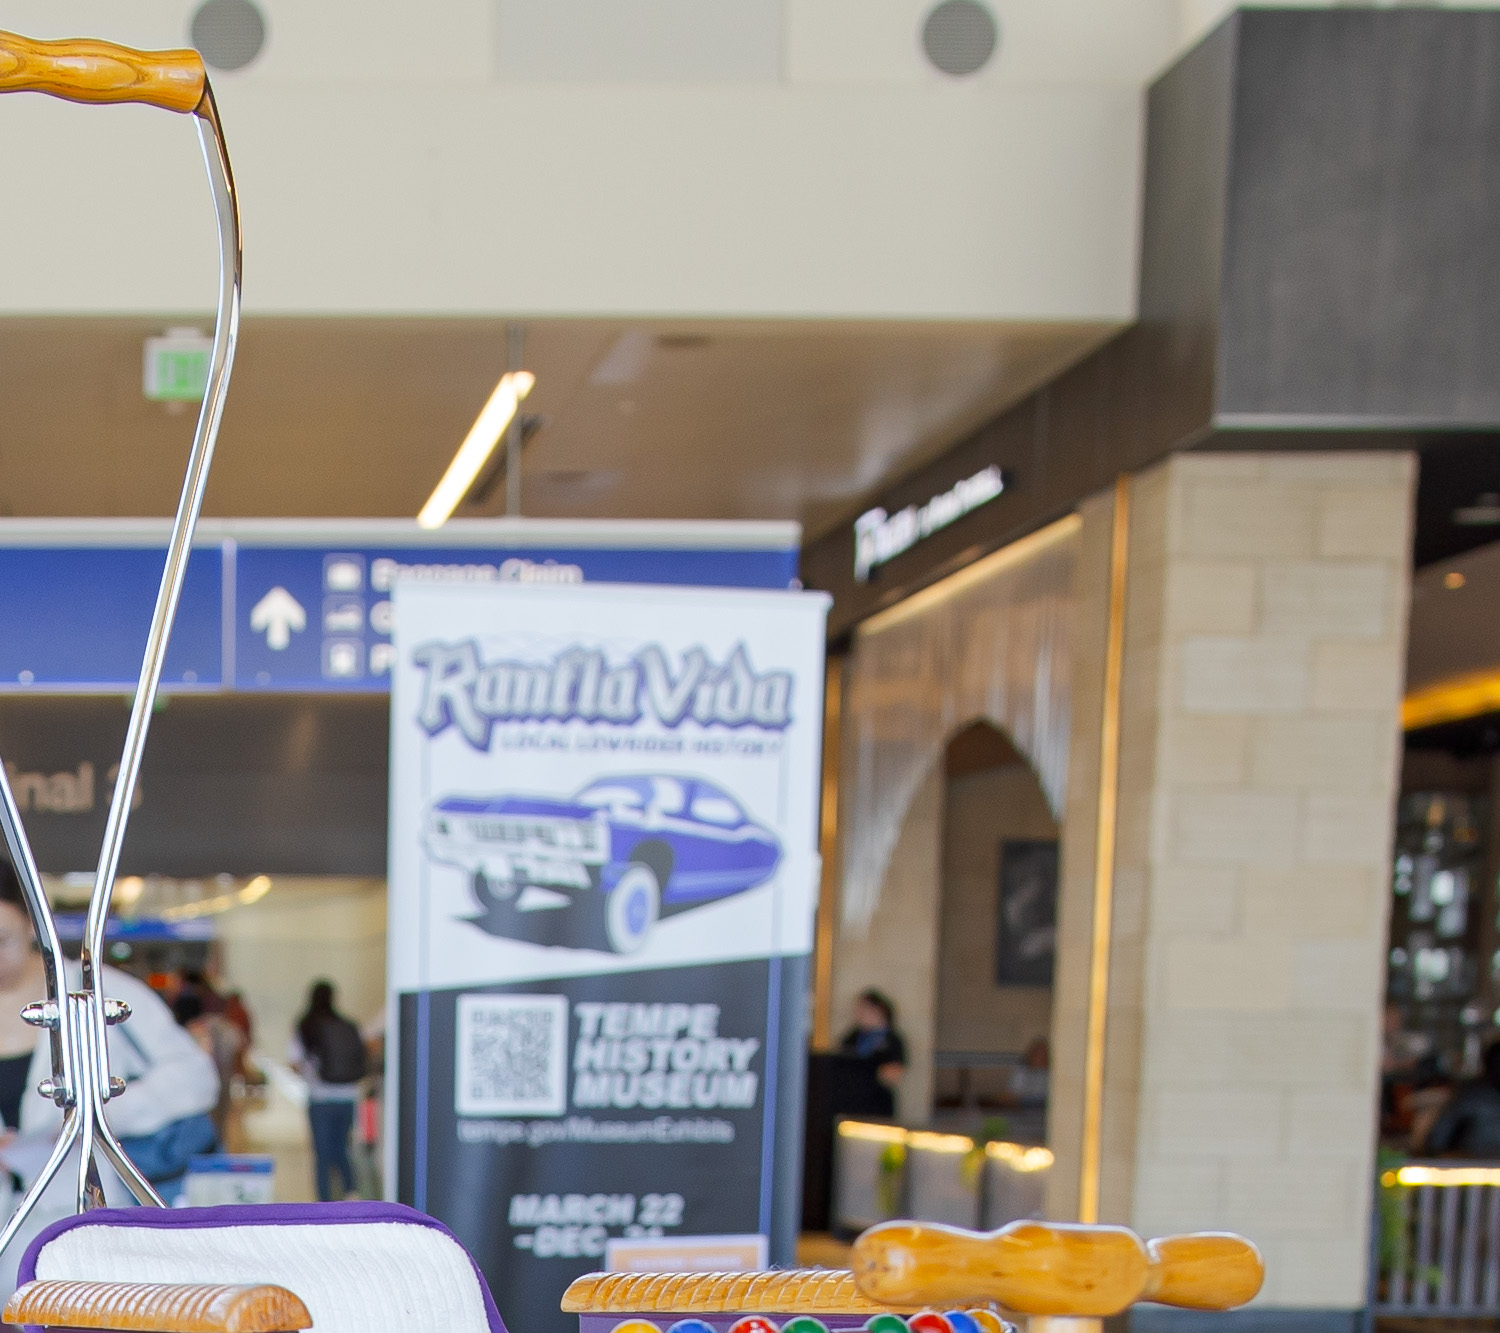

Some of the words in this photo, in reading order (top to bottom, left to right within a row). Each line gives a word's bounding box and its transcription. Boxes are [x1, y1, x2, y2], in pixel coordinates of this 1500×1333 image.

[633, 637, 794, 733] Vida
[573, 1002, 722, 1038] TEMPE
[573, 1036, 761, 1073] HISTORY
[572, 1070, 759, 1109] MUSEUM
[508, 1193, 636, 1227] MARCH
[637, 1192, 686, 1227] 22
